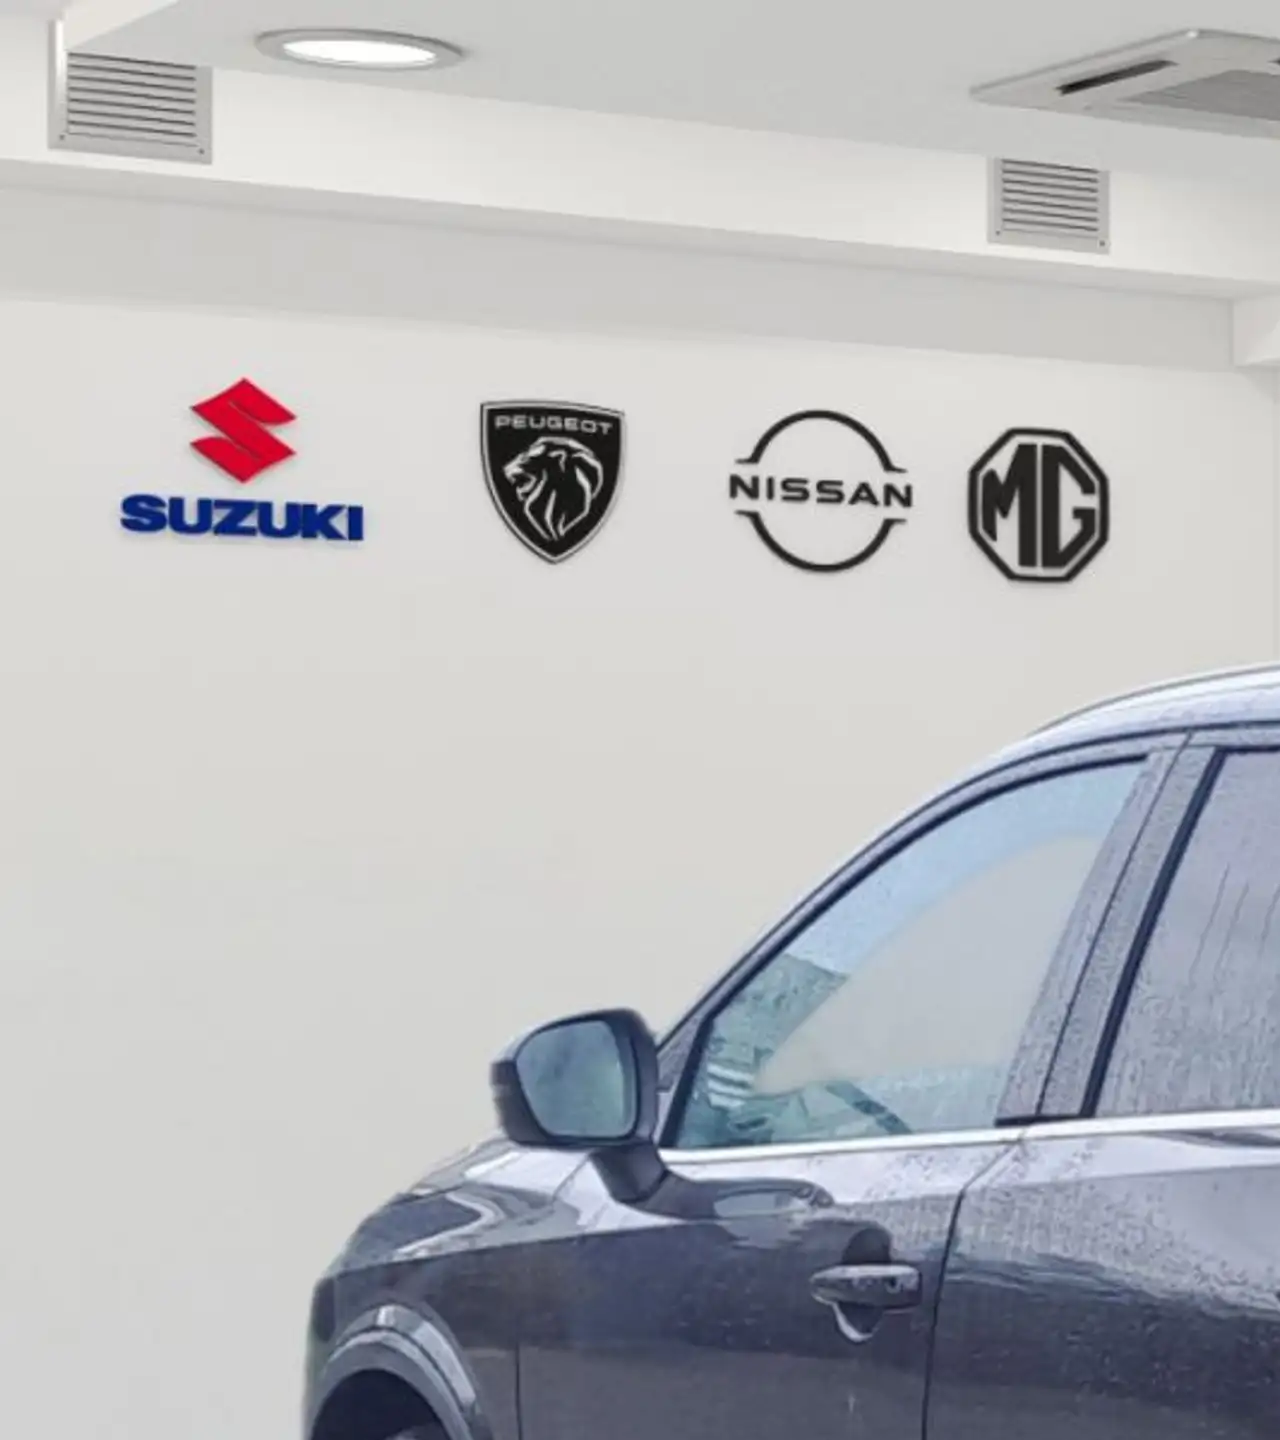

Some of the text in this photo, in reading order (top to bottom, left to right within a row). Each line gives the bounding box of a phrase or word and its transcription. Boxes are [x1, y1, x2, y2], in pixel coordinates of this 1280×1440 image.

[494, 414, 613, 435] PEUGEOT
[729, 474, 914, 507] NISSAN
[981, 443, 1097, 568] MG
[121, 494, 364, 541] SUZUKI
